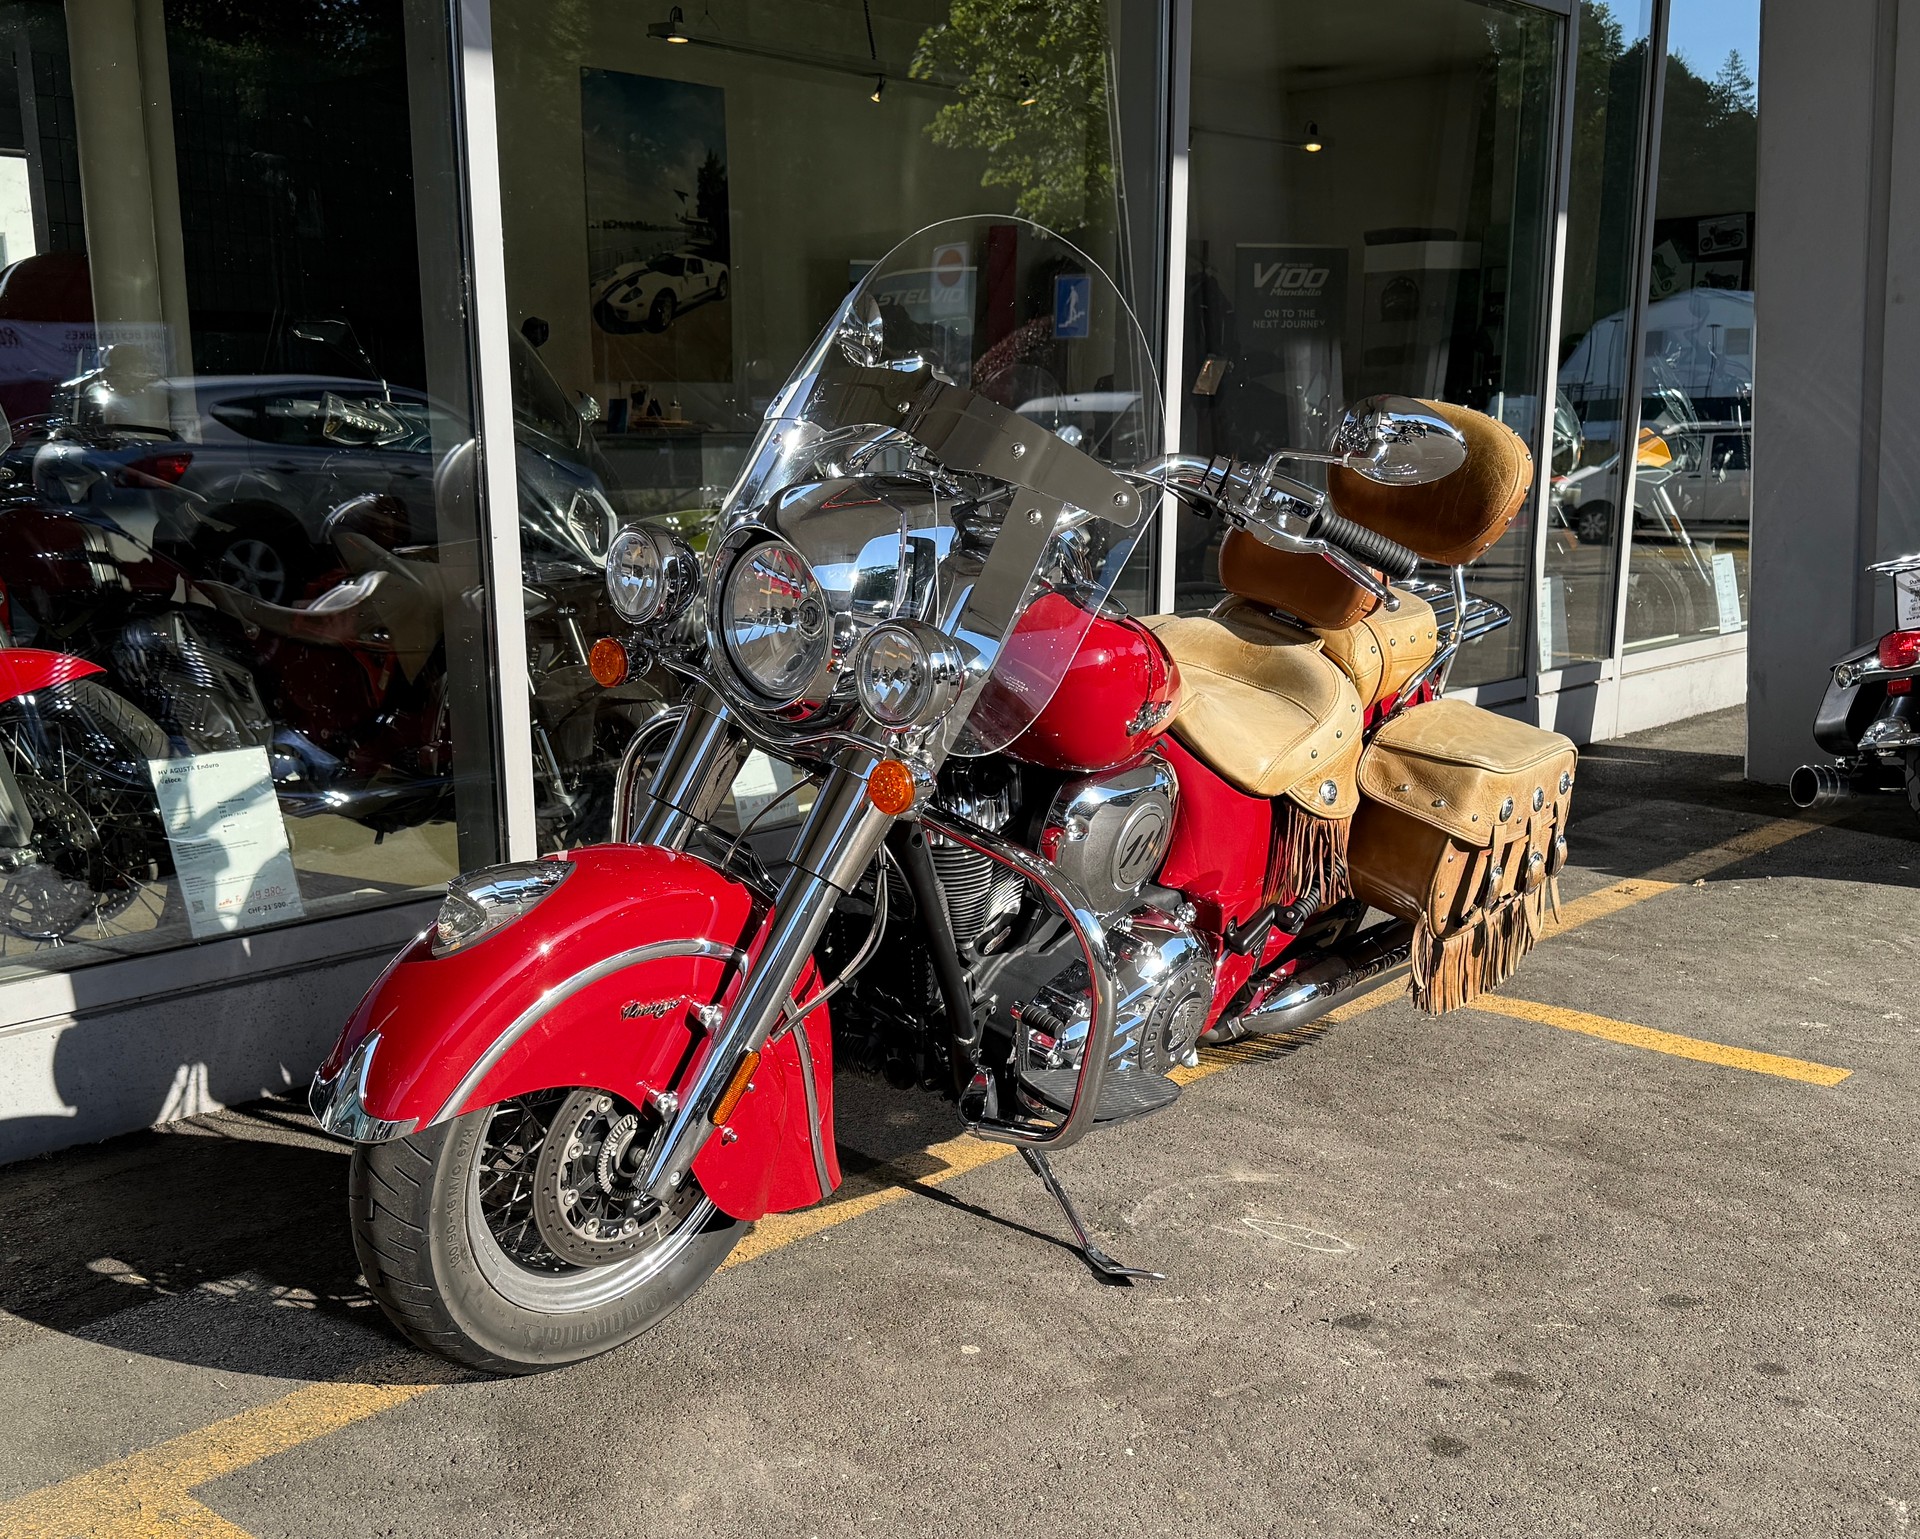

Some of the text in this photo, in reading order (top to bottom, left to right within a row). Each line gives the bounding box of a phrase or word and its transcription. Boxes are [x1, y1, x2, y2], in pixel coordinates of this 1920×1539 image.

[1253, 262, 1330, 288] V100
[878, 288, 965, 306] STELVIO
[1269, 287, 1322, 297] Mandello
[1264, 309, 1316, 318] ON TO THE
[1253, 319, 1326, 329] NEXT JOURNEY
[169, 765, 196, 775] AGUSTA
[196, 762, 220, 771] Enduro
[248, 906, 261, 915] CHF
